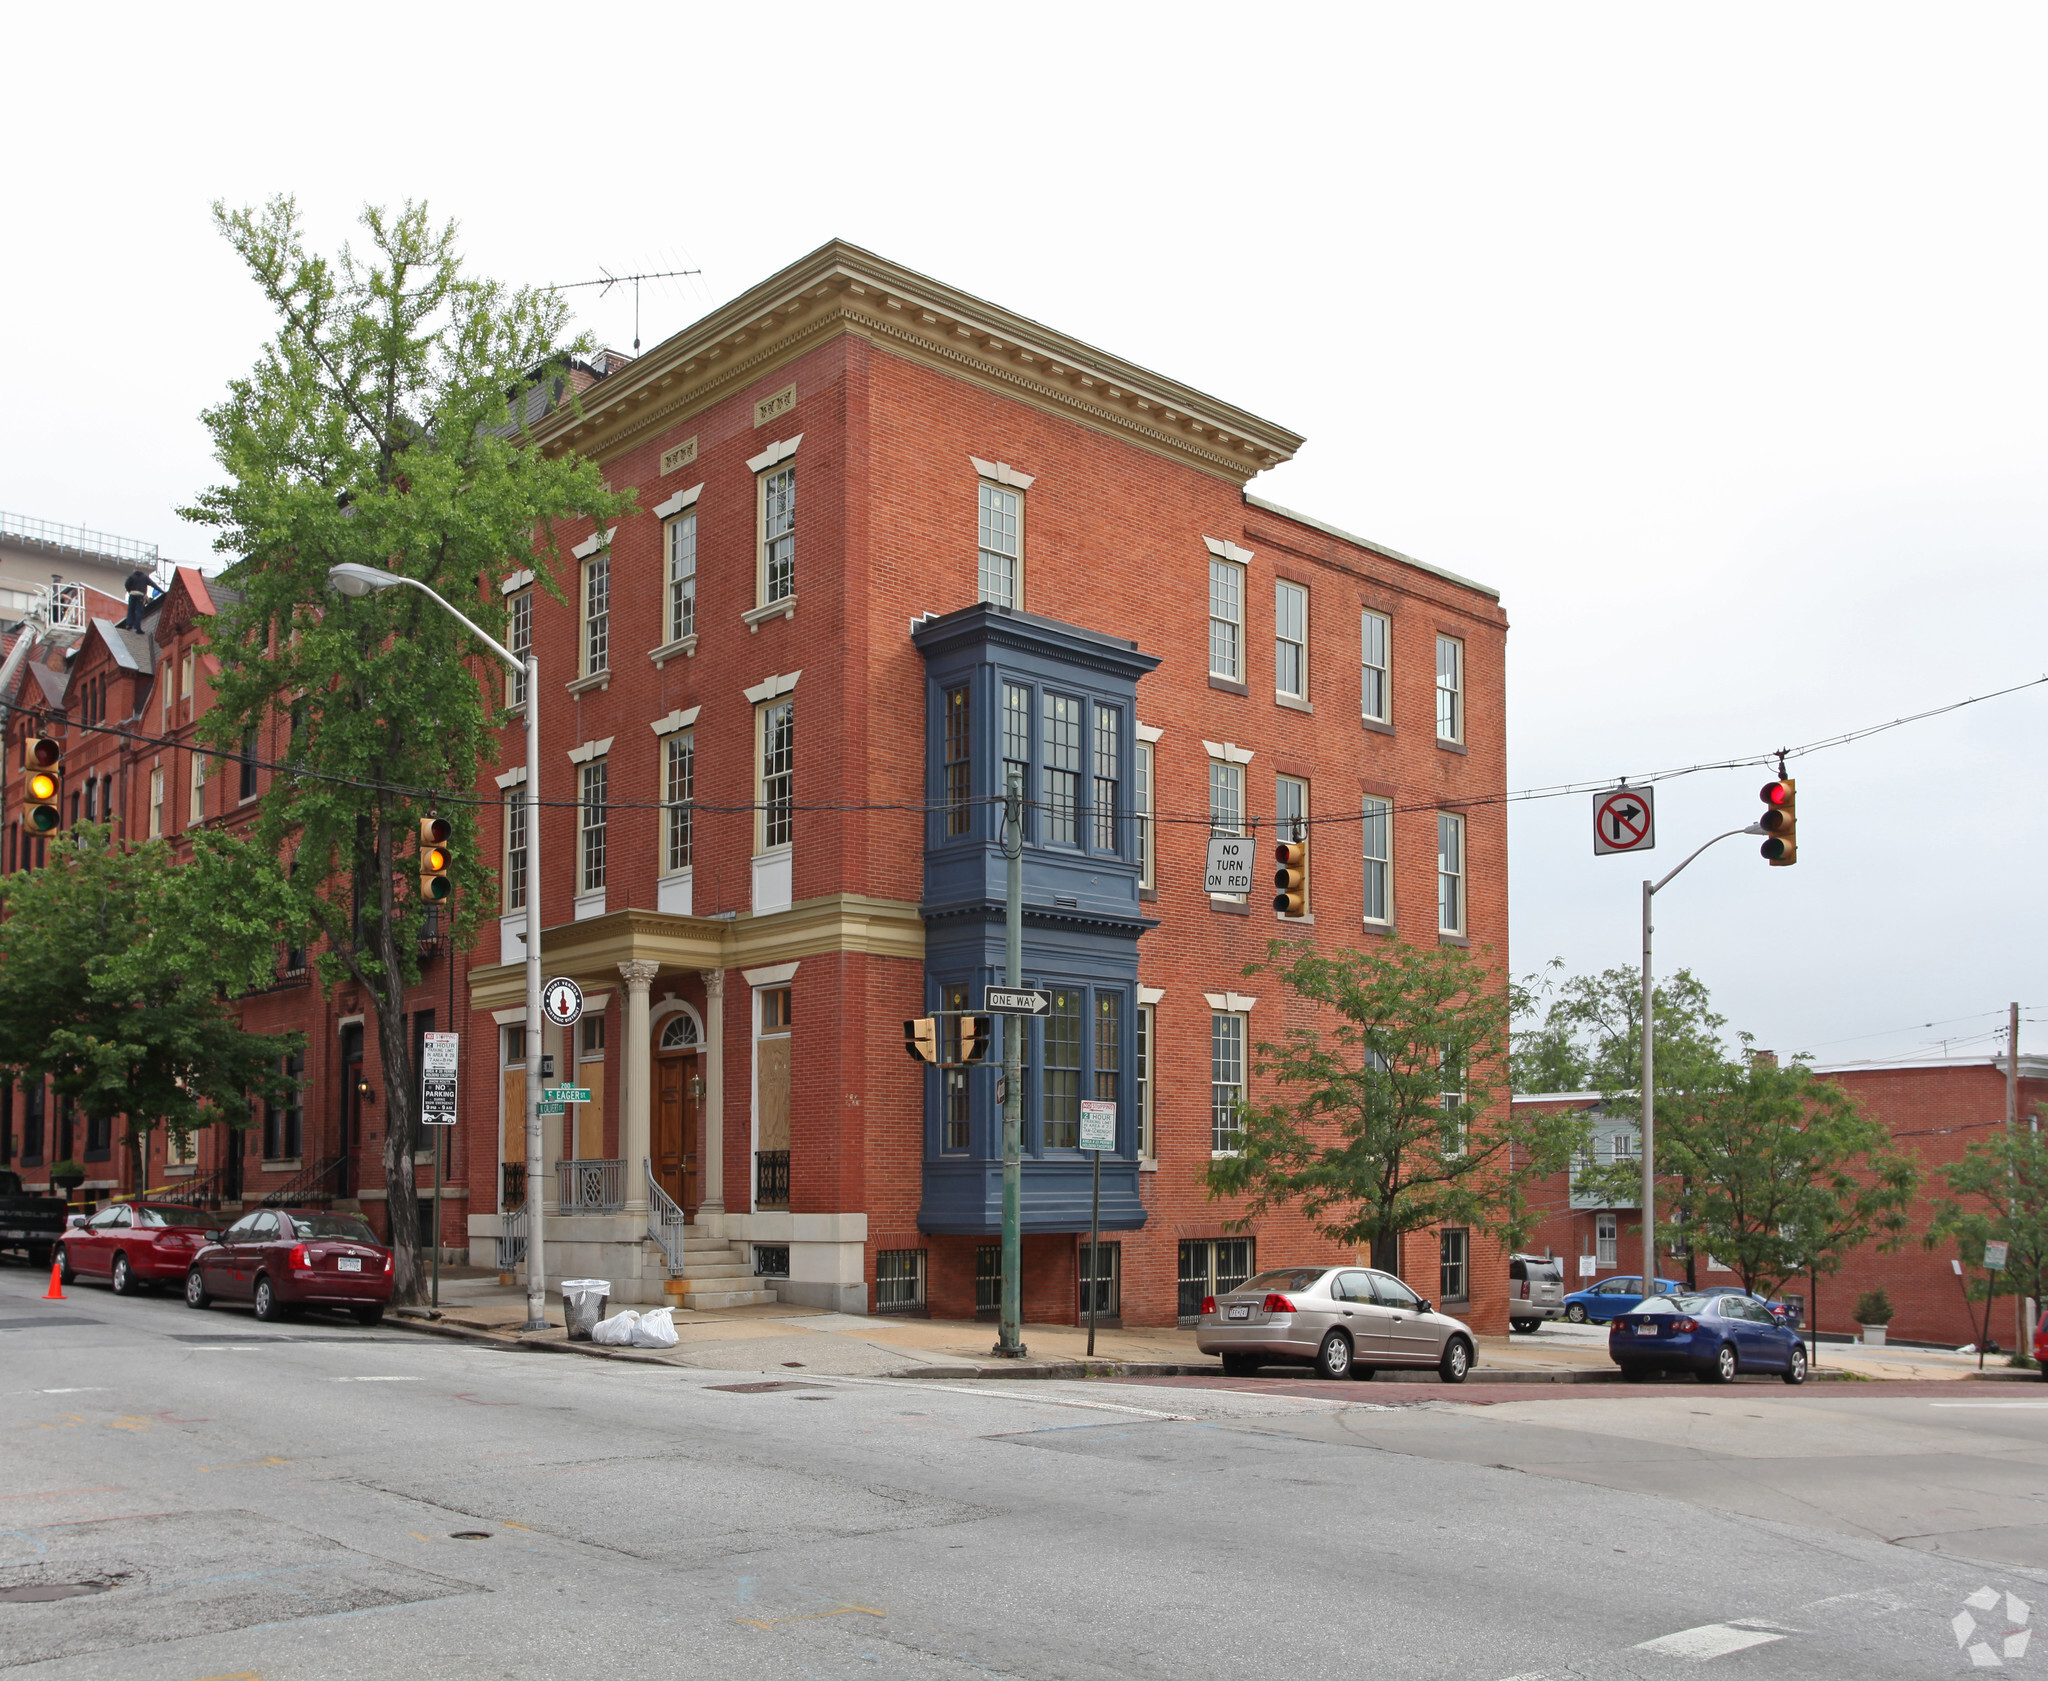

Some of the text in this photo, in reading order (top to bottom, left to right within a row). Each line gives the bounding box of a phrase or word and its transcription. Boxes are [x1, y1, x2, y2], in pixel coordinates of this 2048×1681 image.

[1222, 845, 1239, 855] NO
[1217, 860, 1243, 870] TURN
[1208, 875, 1248, 886] ON RED
[547, 981, 579, 996] MOUNT VERNON
[992, 994, 1037, 1007] ONE WAY
[547, 1007, 580, 1022] HISTORIC DISTRICT
[556, 1091, 580, 1100] EAGER
